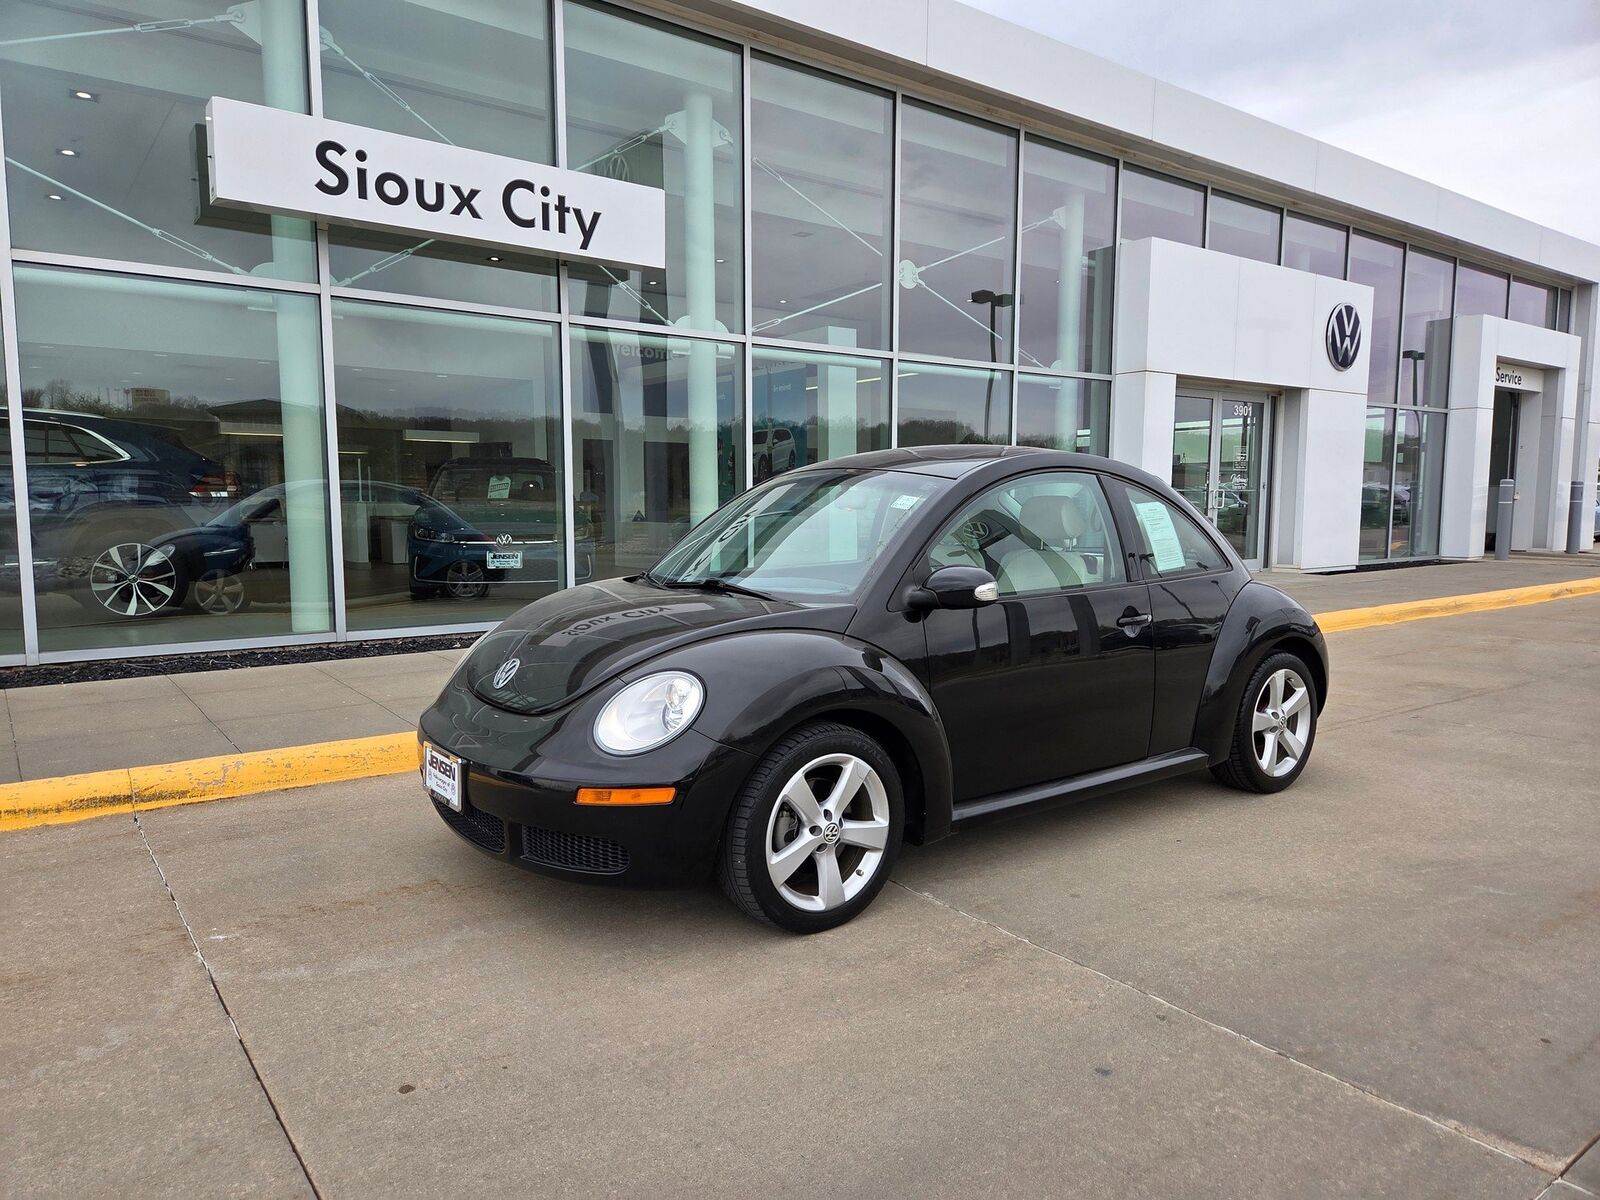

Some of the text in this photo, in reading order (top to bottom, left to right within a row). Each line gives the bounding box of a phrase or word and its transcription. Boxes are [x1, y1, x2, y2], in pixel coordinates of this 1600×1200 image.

[314, 140, 602, 250] Sioux City
[1496, 366, 1522, 386] Service
[1233, 405, 1252, 417] 3901
[428, 753, 456, 782] JENSEN
